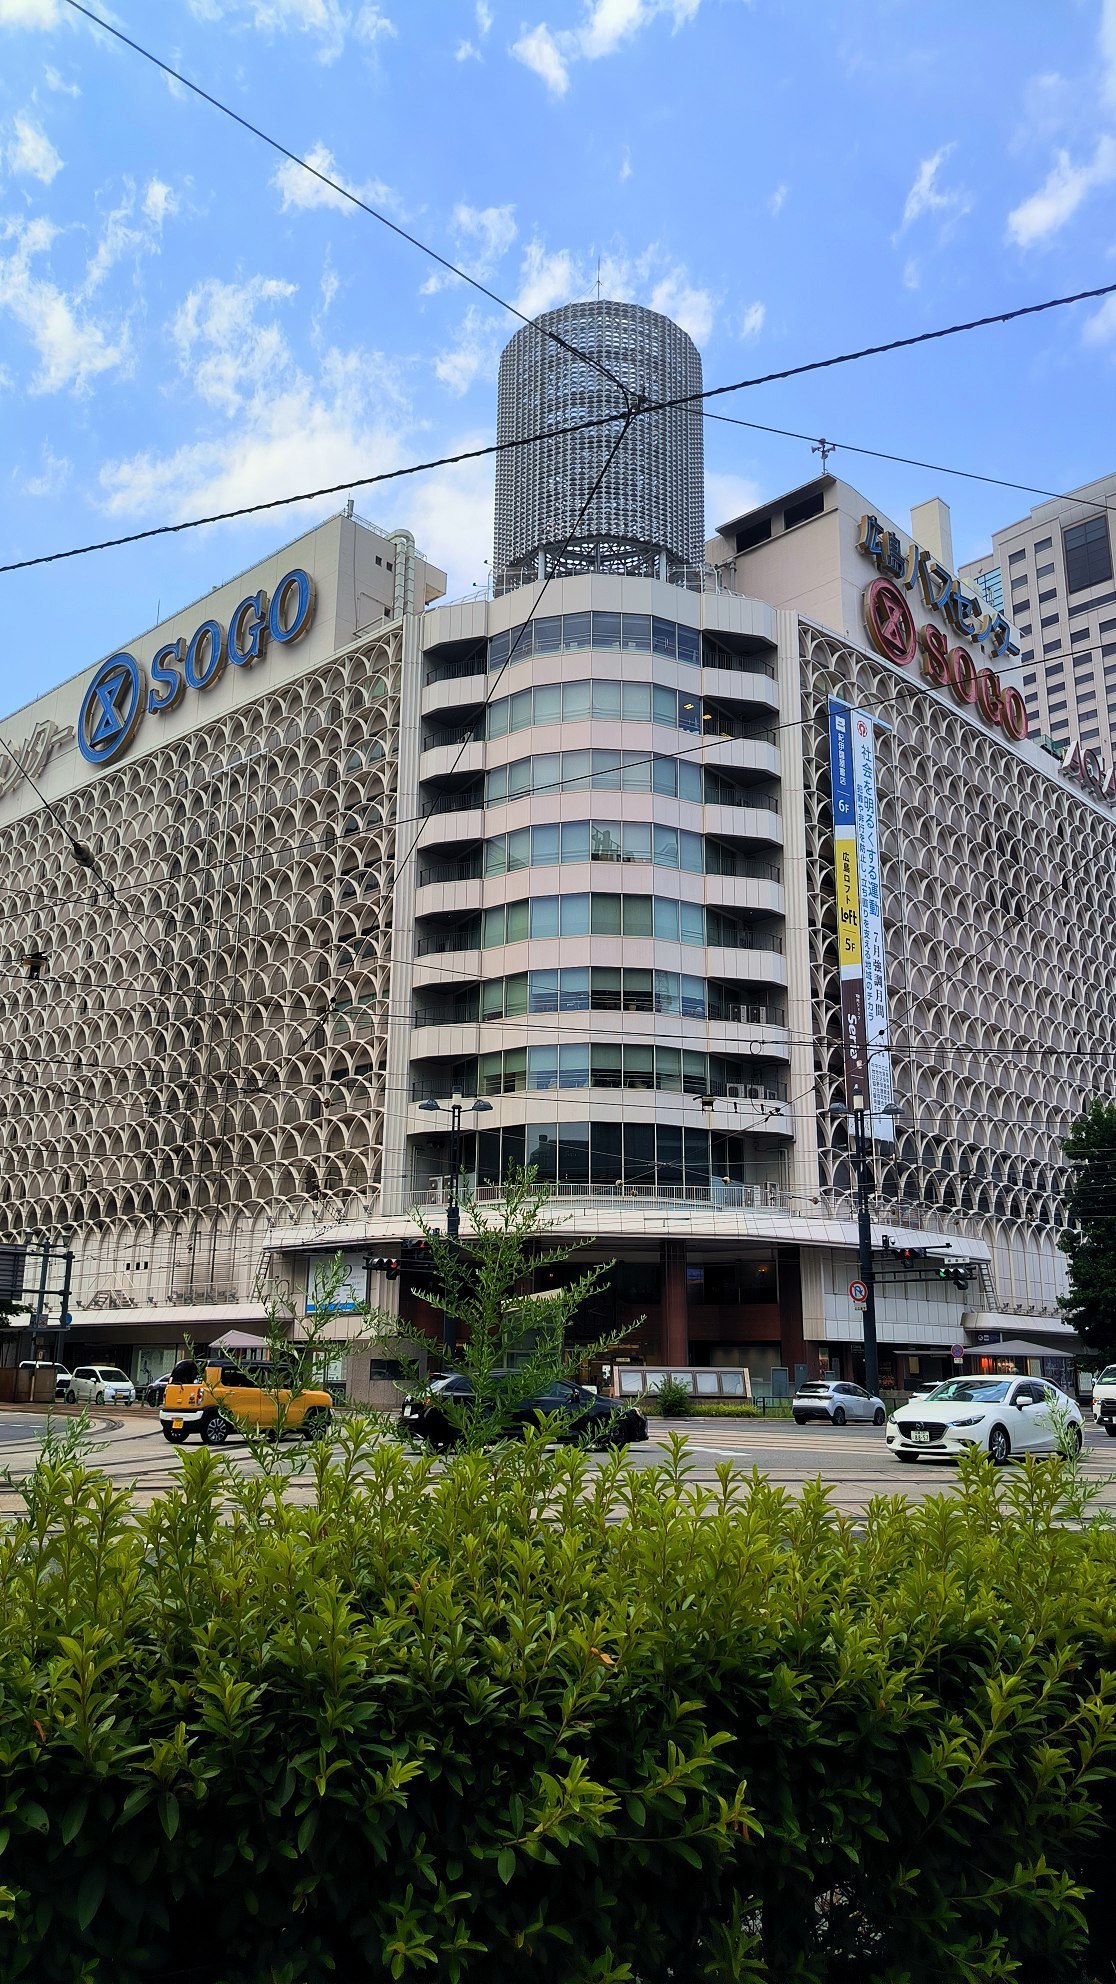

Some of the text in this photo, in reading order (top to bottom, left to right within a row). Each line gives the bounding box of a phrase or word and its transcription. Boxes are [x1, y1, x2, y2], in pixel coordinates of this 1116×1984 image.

[857, 514, 1020, 658] 広島バスセンター
[148, 568, 316, 715] SOGO
[918, 623, 1029, 741] SOGO
[838, 799, 850, 814] 6F
[842, 851, 851, 905] 広島ロフト
[845, 938, 856, 952] 5F
[847, 1013, 860, 1060] Seria
